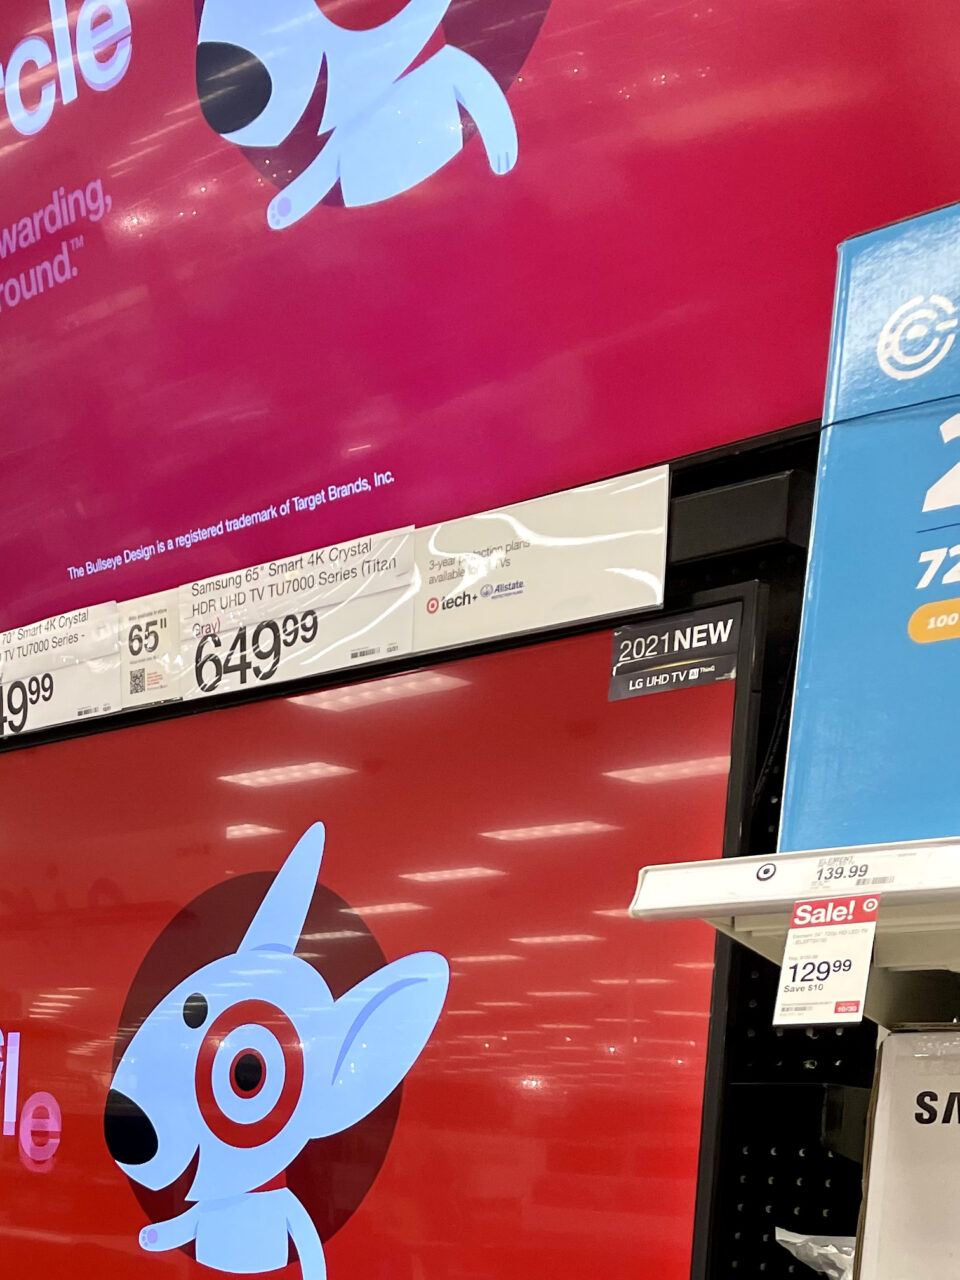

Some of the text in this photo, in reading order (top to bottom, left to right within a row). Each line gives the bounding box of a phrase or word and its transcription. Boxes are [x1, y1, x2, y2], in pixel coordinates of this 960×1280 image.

[67, 470, 394, 581] The Bullseye Design is a registered trademark of Target Brands, Inc.
[191, 539, 372, 597] Samsung Smart 4K Crystal
[429, 555, 455, 571] 3-year
[505, 539, 530, 554] plans
[192, 597, 217, 617] HDR
[220, 591, 246, 612] UHD
[248, 587, 265, 605] TV
[268, 578, 315, 600] TU7000
[319, 567, 357, 586] Series
[361, 556, 397, 578] (Titan
[494, 580, 524, 594] Allstate
[17, 624, 42, 641] Smart
[44, 618, 57, 633] 4K
[58, 610, 89, 630] Crystal
[927, 612, 959, 630] 100
[4, 648, 16, 663] TV
[17, 640, 50, 661] TU7000
[51, 632, 78, 650] Series
[618, 619, 733, 662] 2021 NEW
[629, 671, 687, 690] LG UHD TV
[816, 864, 869, 882] 139.99
[794, 900, 856, 925] Sale!
[784, 984, 824, 993] Save $10
